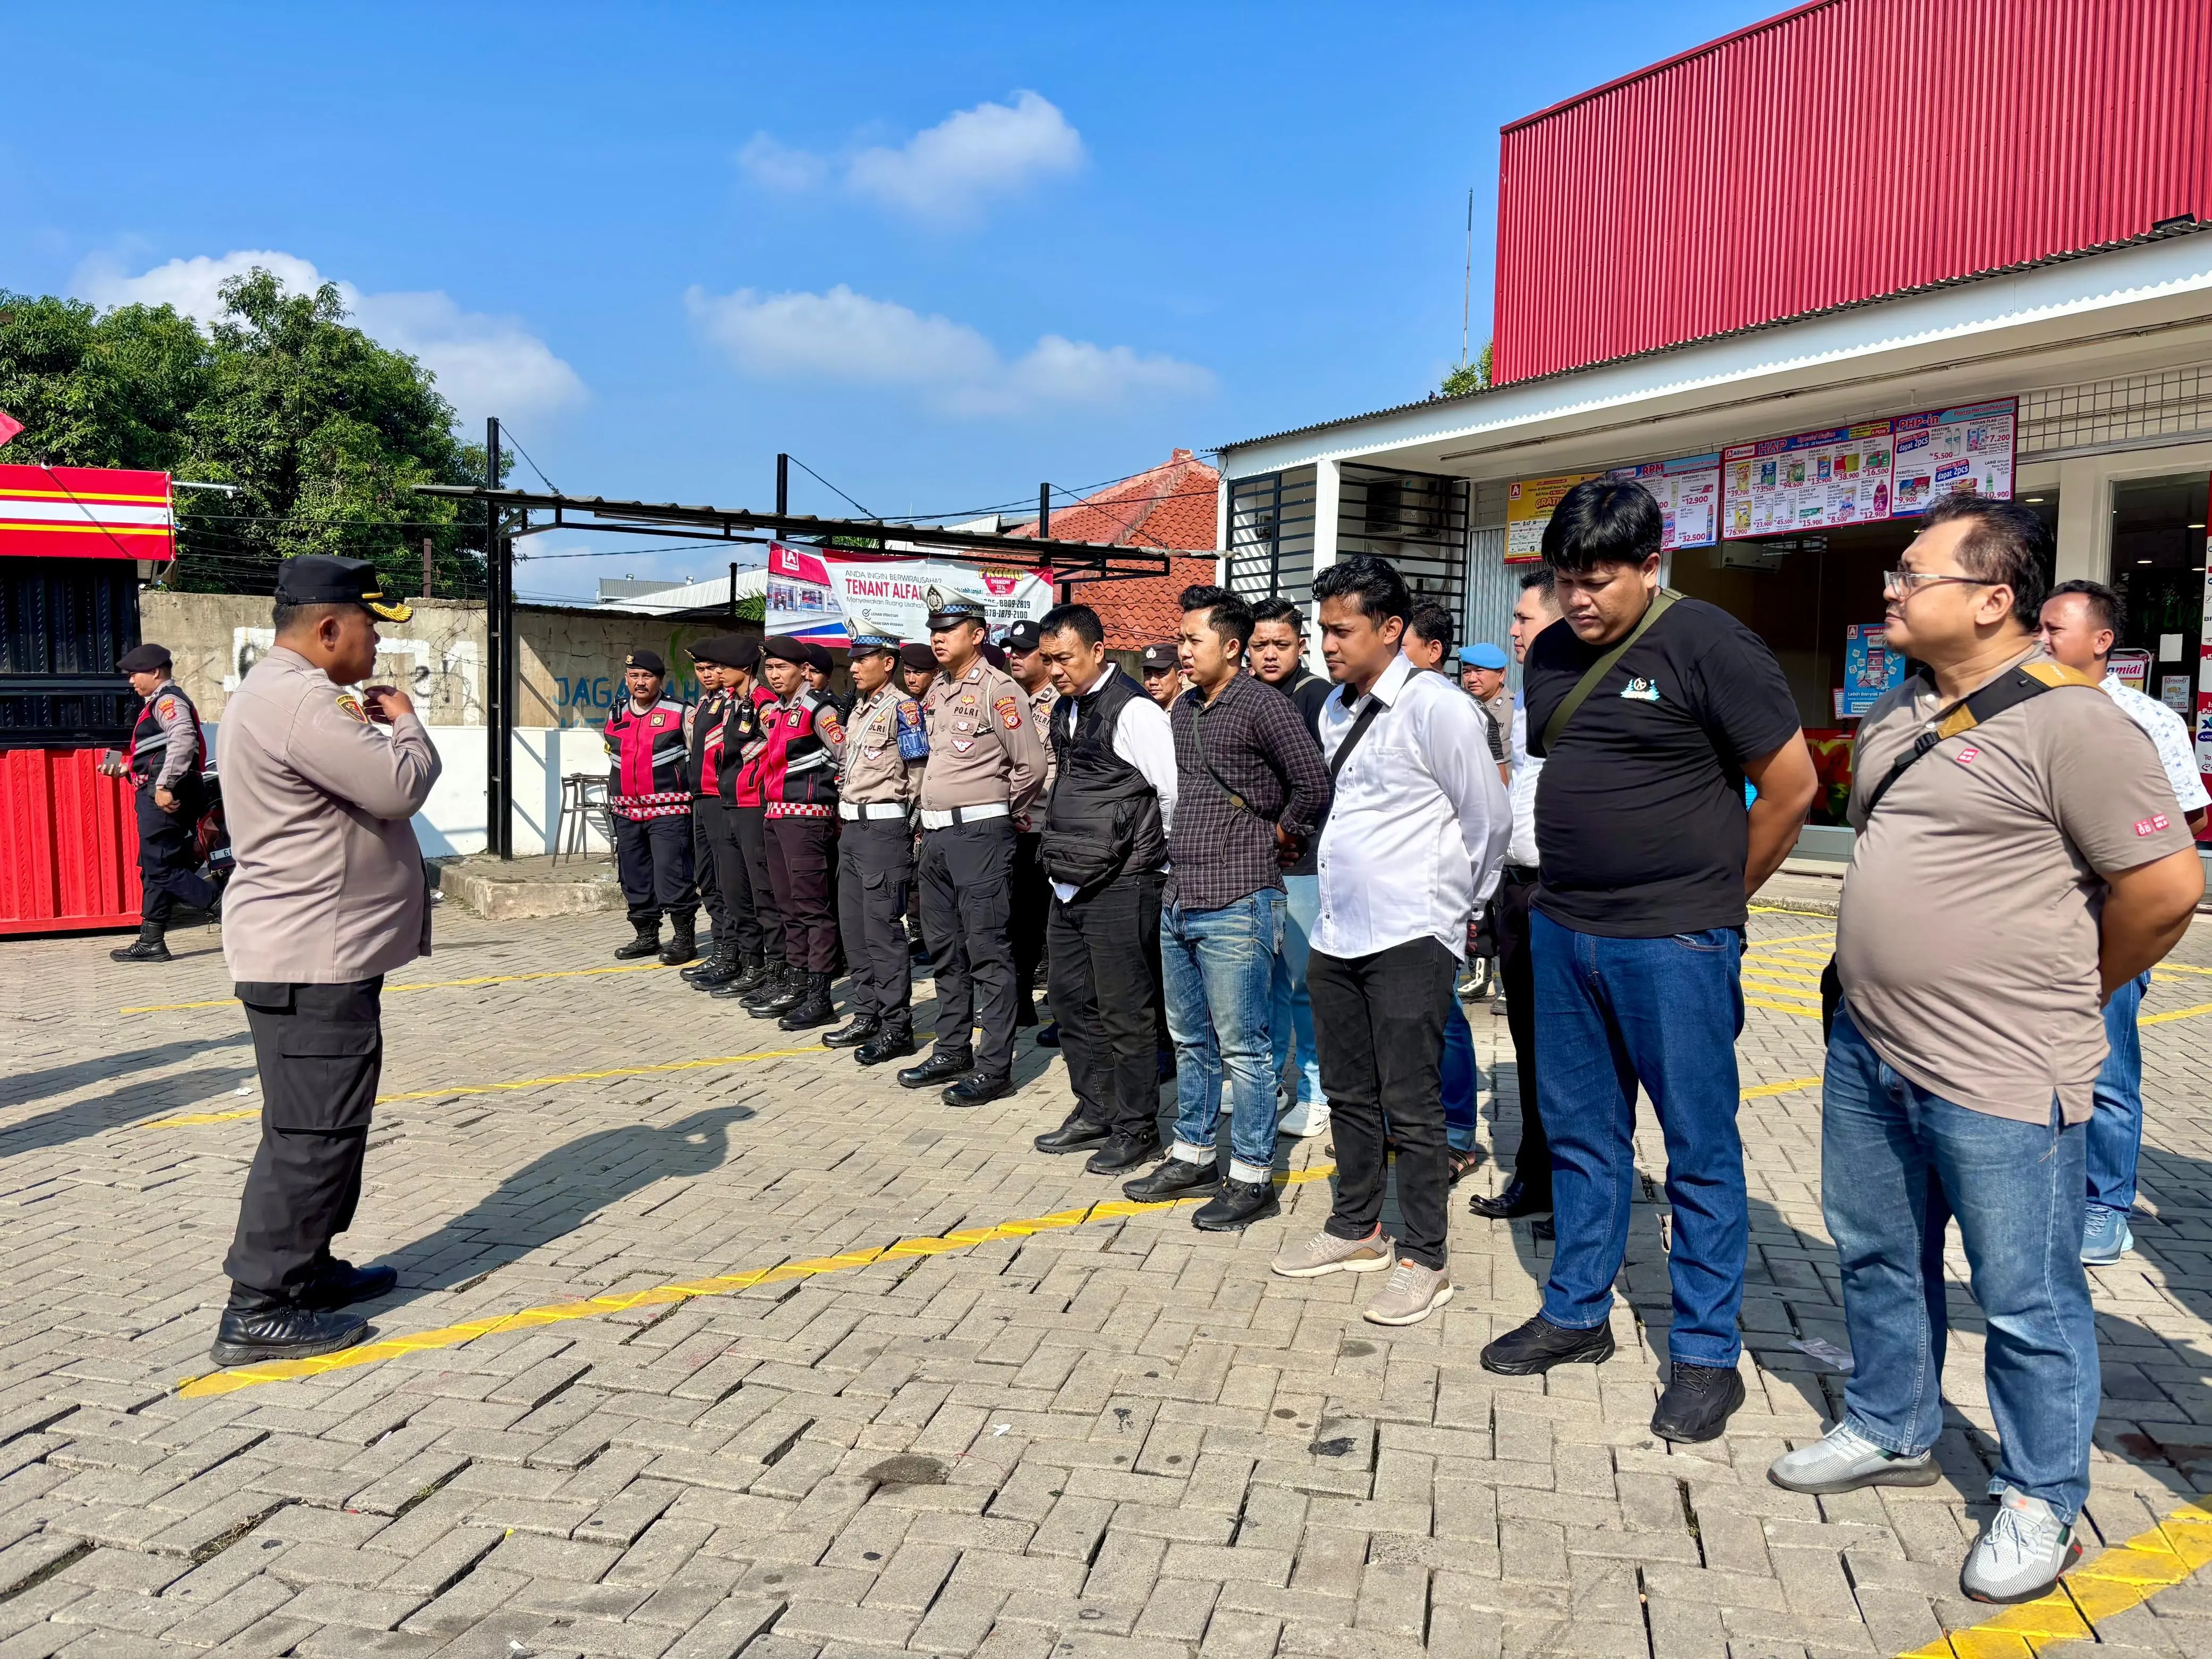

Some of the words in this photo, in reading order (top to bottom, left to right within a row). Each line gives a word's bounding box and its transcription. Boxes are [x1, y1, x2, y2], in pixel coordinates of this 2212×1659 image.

[1899, 414, 1939, 430] PHP-in
[1990, 434, 2010, 443] 7.200
[1758, 439, 1787, 456] HAP
[1899, 442, 1913, 451] dapat
[1914, 437, 1929, 448] 2pcs
[1933, 451, 1953, 460] 5.500
[1642, 463, 1664, 475] RPM
[1866, 467, 1889, 476] 16.500
[1937, 471, 1952, 480] dapat
[1953, 465, 1968, 477] 2pcs
[1811, 476, 1832, 485] 13.900
[1838, 472, 1859, 481] 38.900
[1756, 485, 1775, 493] 73.500
[1685, 495, 1708, 505] 12.900
[1898, 496, 1917, 504] 9.900
[1864, 510, 1886, 519] 12.900
[1682, 533, 1706, 542] 32.500
[845, 570, 866, 579] ANDA
[867, 572, 887, 580] INGIN
[890, 574, 942, 584] BERWIRAUSAHA?
[978, 567, 1024, 582] PROMO
[845, 578, 890, 598] TENANT
[847, 596, 884, 606] Menyewakan
[904, 600, 927, 609] Usaha/C
[984, 599, 1030, 609] -8809-2819
[985, 609, 1028, 619] 878-1879-2100
[2106, 664, 2142, 675] amidi
[954, 706, 979, 717] POLRI
[868, 723, 885, 733] OLRI
